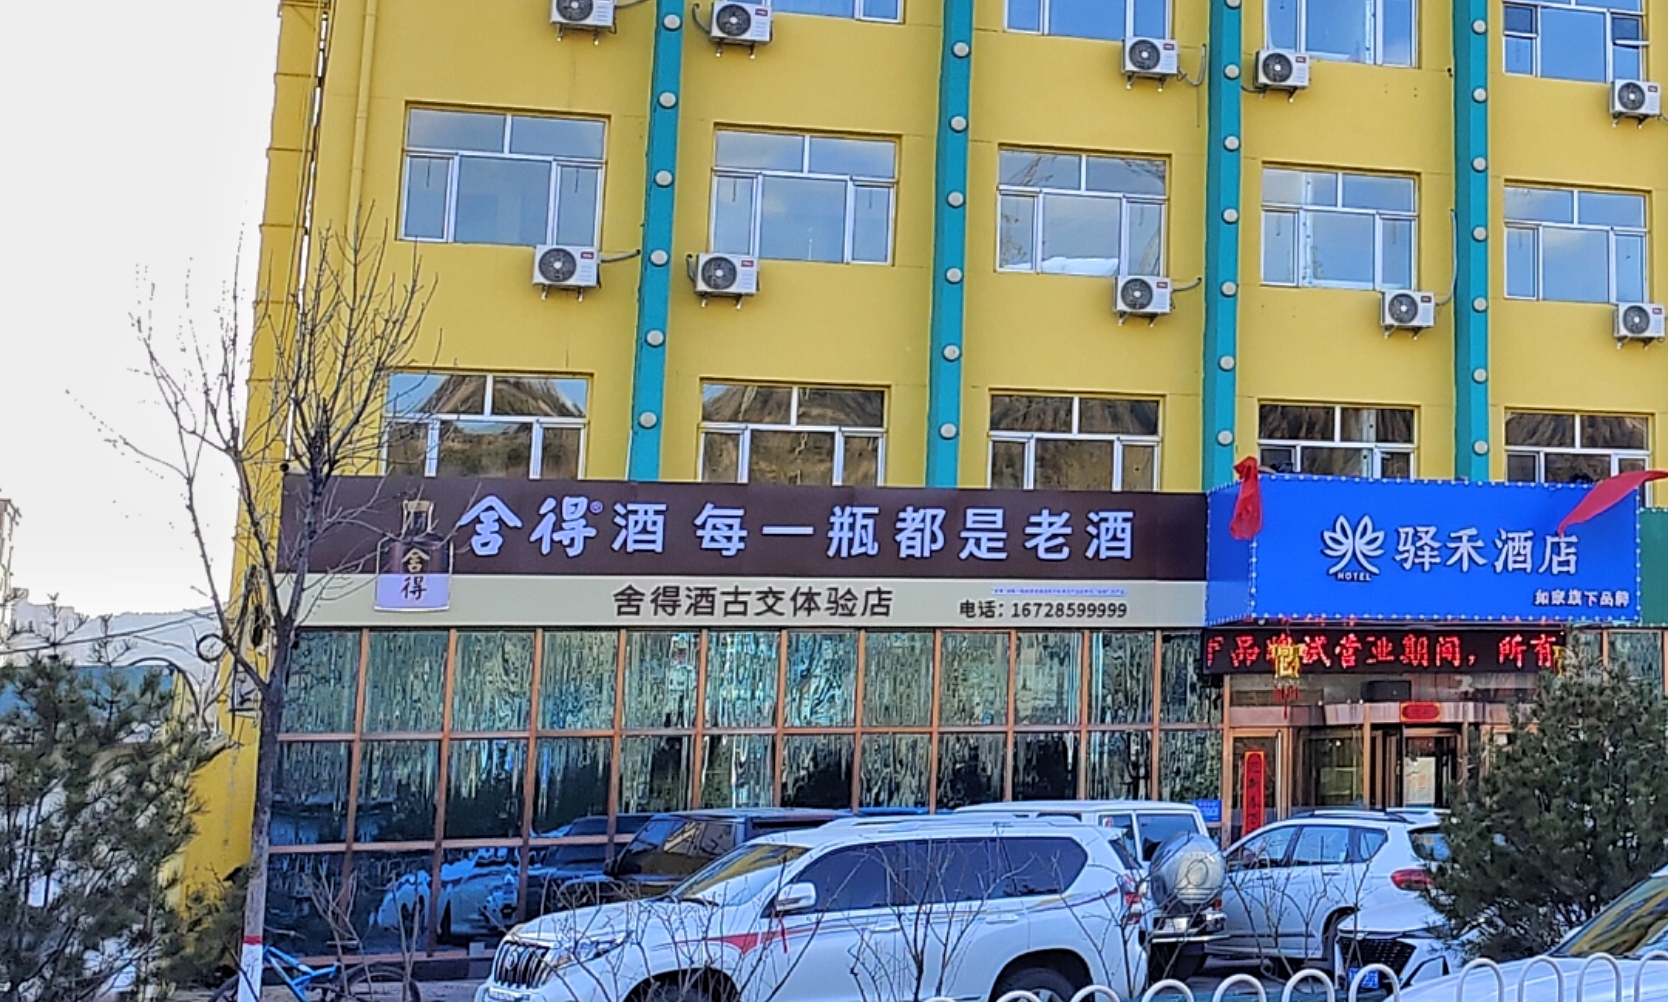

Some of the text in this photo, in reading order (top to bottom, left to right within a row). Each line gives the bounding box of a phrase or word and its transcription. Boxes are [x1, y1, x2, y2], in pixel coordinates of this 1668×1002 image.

[1394, 525, 1579, 575] 驿禾酒店
[1337, 571, 1372, 581] HOTEL
[612, 584, 894, 618] 舍得酒古交体验店
